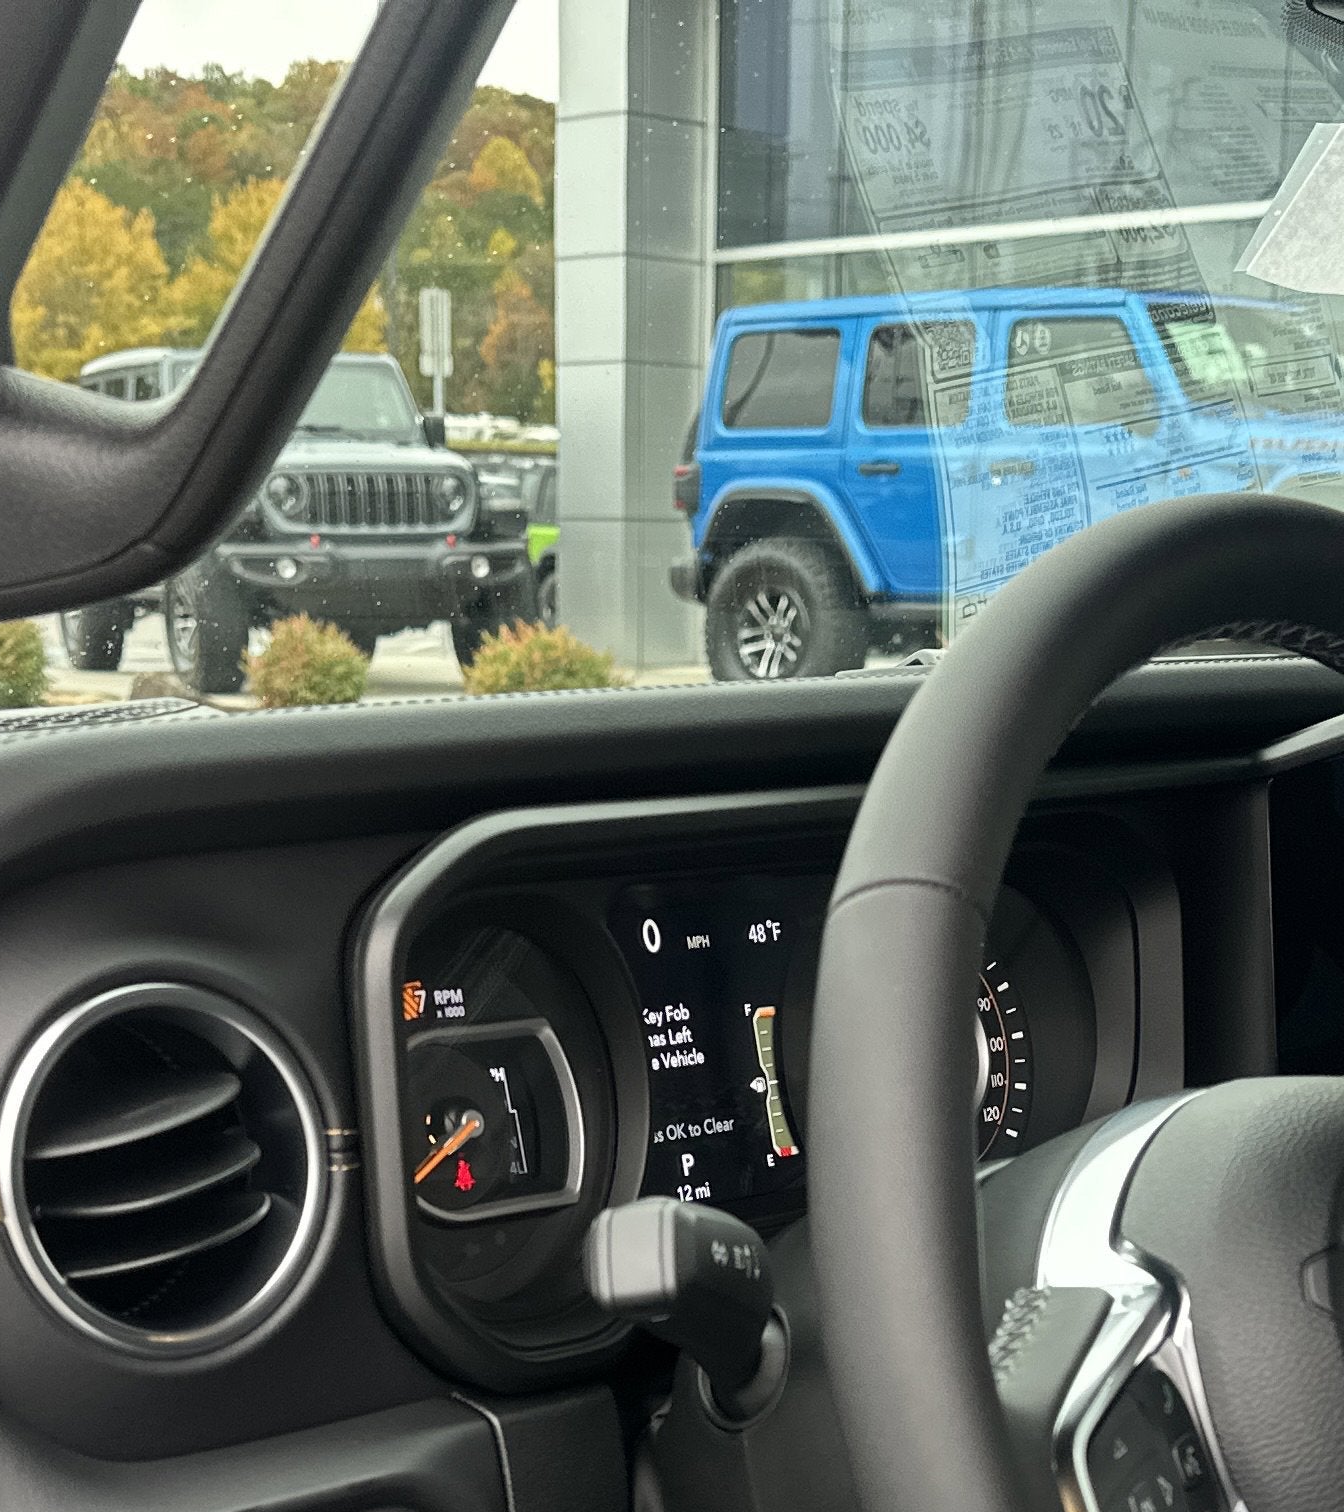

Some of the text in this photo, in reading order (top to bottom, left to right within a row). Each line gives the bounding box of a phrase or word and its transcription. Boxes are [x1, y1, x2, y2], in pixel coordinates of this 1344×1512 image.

[642, 918, 661, 953] 0
[686, 935, 711, 950] MPH
[433, 988, 464, 1006] RPM
[665, 1002, 690, 1023] Fob
[743, 1003, 753, 1017] F
[668, 1025, 694, 1046] Left
[660, 1047, 705, 1069] Vehicle
[982, 1105, 1001, 1122] 120
[666, 1122, 688, 1142] OK
[688, 1123, 702, 1138] to
[703, 1117, 735, 1135] Clear
[681, 1153, 695, 1177] P
[766, 1154, 776, 1167] E
[676, 1181, 711, 1202] 12 mi
